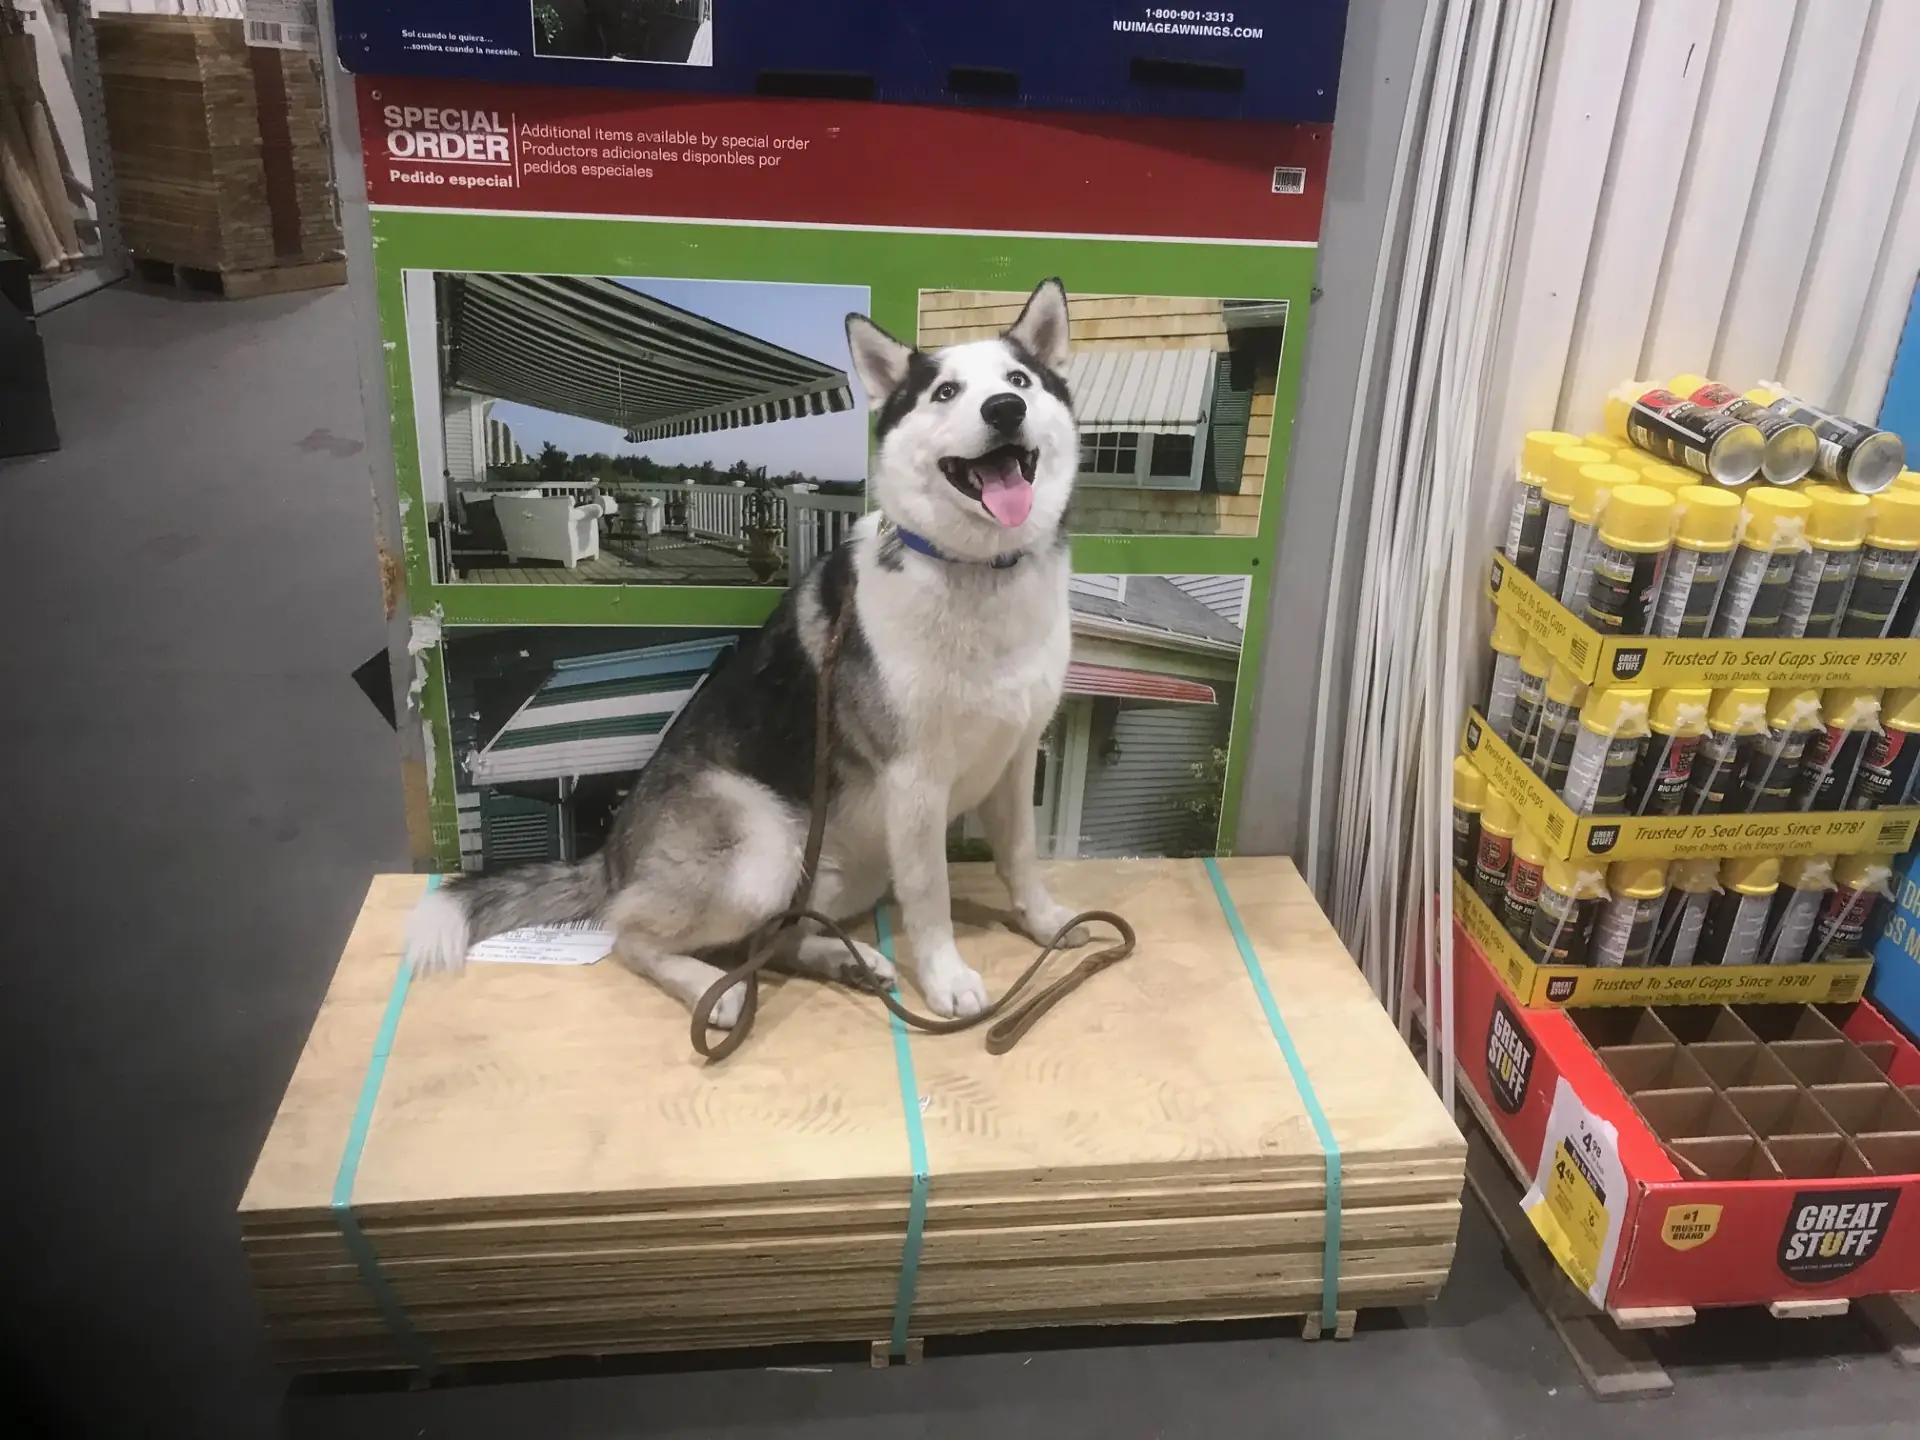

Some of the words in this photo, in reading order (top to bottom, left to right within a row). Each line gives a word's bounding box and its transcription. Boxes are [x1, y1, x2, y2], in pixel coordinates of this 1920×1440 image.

[401, 29, 415, 38] Sol
[417, 31, 447, 39] cuando
[449, 32, 457, 40] lo
[1113, 20, 1263, 39] NUIMAGEAWNINGS.COM
[445, 45, 474, 53] cuando
[475, 46, 483, 54] la
[485, 47, 521, 56] necesite.
[383, 105, 508, 133] SPECIAL
[387, 130, 510, 161] ORDER
[521, 123, 591, 140] Additional
[595, 128, 633, 141] items
[637, 130, 697, 145] available
[701, 132, 718, 149] by
[722, 135, 769, 149] special
[773, 136, 810, 150] order
[522, 141, 598, 158] Productors
[602, 146, 678, 161] adicionales
[682, 149, 755, 166] disponbles
[759, 155, 781, 168] por
[390, 169, 444, 184] Pedido
[449, 175, 513, 189] especial
[524, 160, 577, 176] pedidos
[581, 164, 653, 179] especiales
[1616, 662, 1640, 671] STUFF
[1618, 654, 1641, 662] GREAT
[1662, 651, 1719, 666] Trusted
[1721, 651, 1737, 665] To
[1741, 651, 1777, 666] Seal
[1778, 651, 1817, 669] Gaps
[1820, 651, 1860, 666] Since
[1865, 651, 1908, 666] 1978!
[1702, 671, 1729, 682] Stops
[1766, 671, 1787, 681] Cuts
[1789, 671, 1822, 683] Energy
[1869, 774, 1893, 787] FILLER
[1635, 826, 1687, 840] Trusted
[1691, 825, 1706, 839] To
[1710, 824, 1743, 838] Seal
[1745, 823, 1780, 840] Gaps
[1784, 822, 1822, 836] Since
[1826, 821, 1865, 835] 1978!
[1593, 977, 1644, 992] Trusted
[1647, 977, 1661, 990] To
[1664, 976, 1698, 989] Seal
[1699, 975, 1733, 991] Gaps
[1736, 975, 1773, 988] Since
[1778, 974, 1816, 987] 1978!
[1494, 1009, 1531, 1075] GREAT
[1488, 1034, 1525, 1101] STUFF
[1683, 1210, 1699, 1223] #1
[1796, 1202, 1889, 1231] GREAT
[1671, 1224, 1711, 1232] TRUSTED
[1672, 1232, 1704, 1240] BRAND
[1785, 1229, 1878, 1261] STUFF
